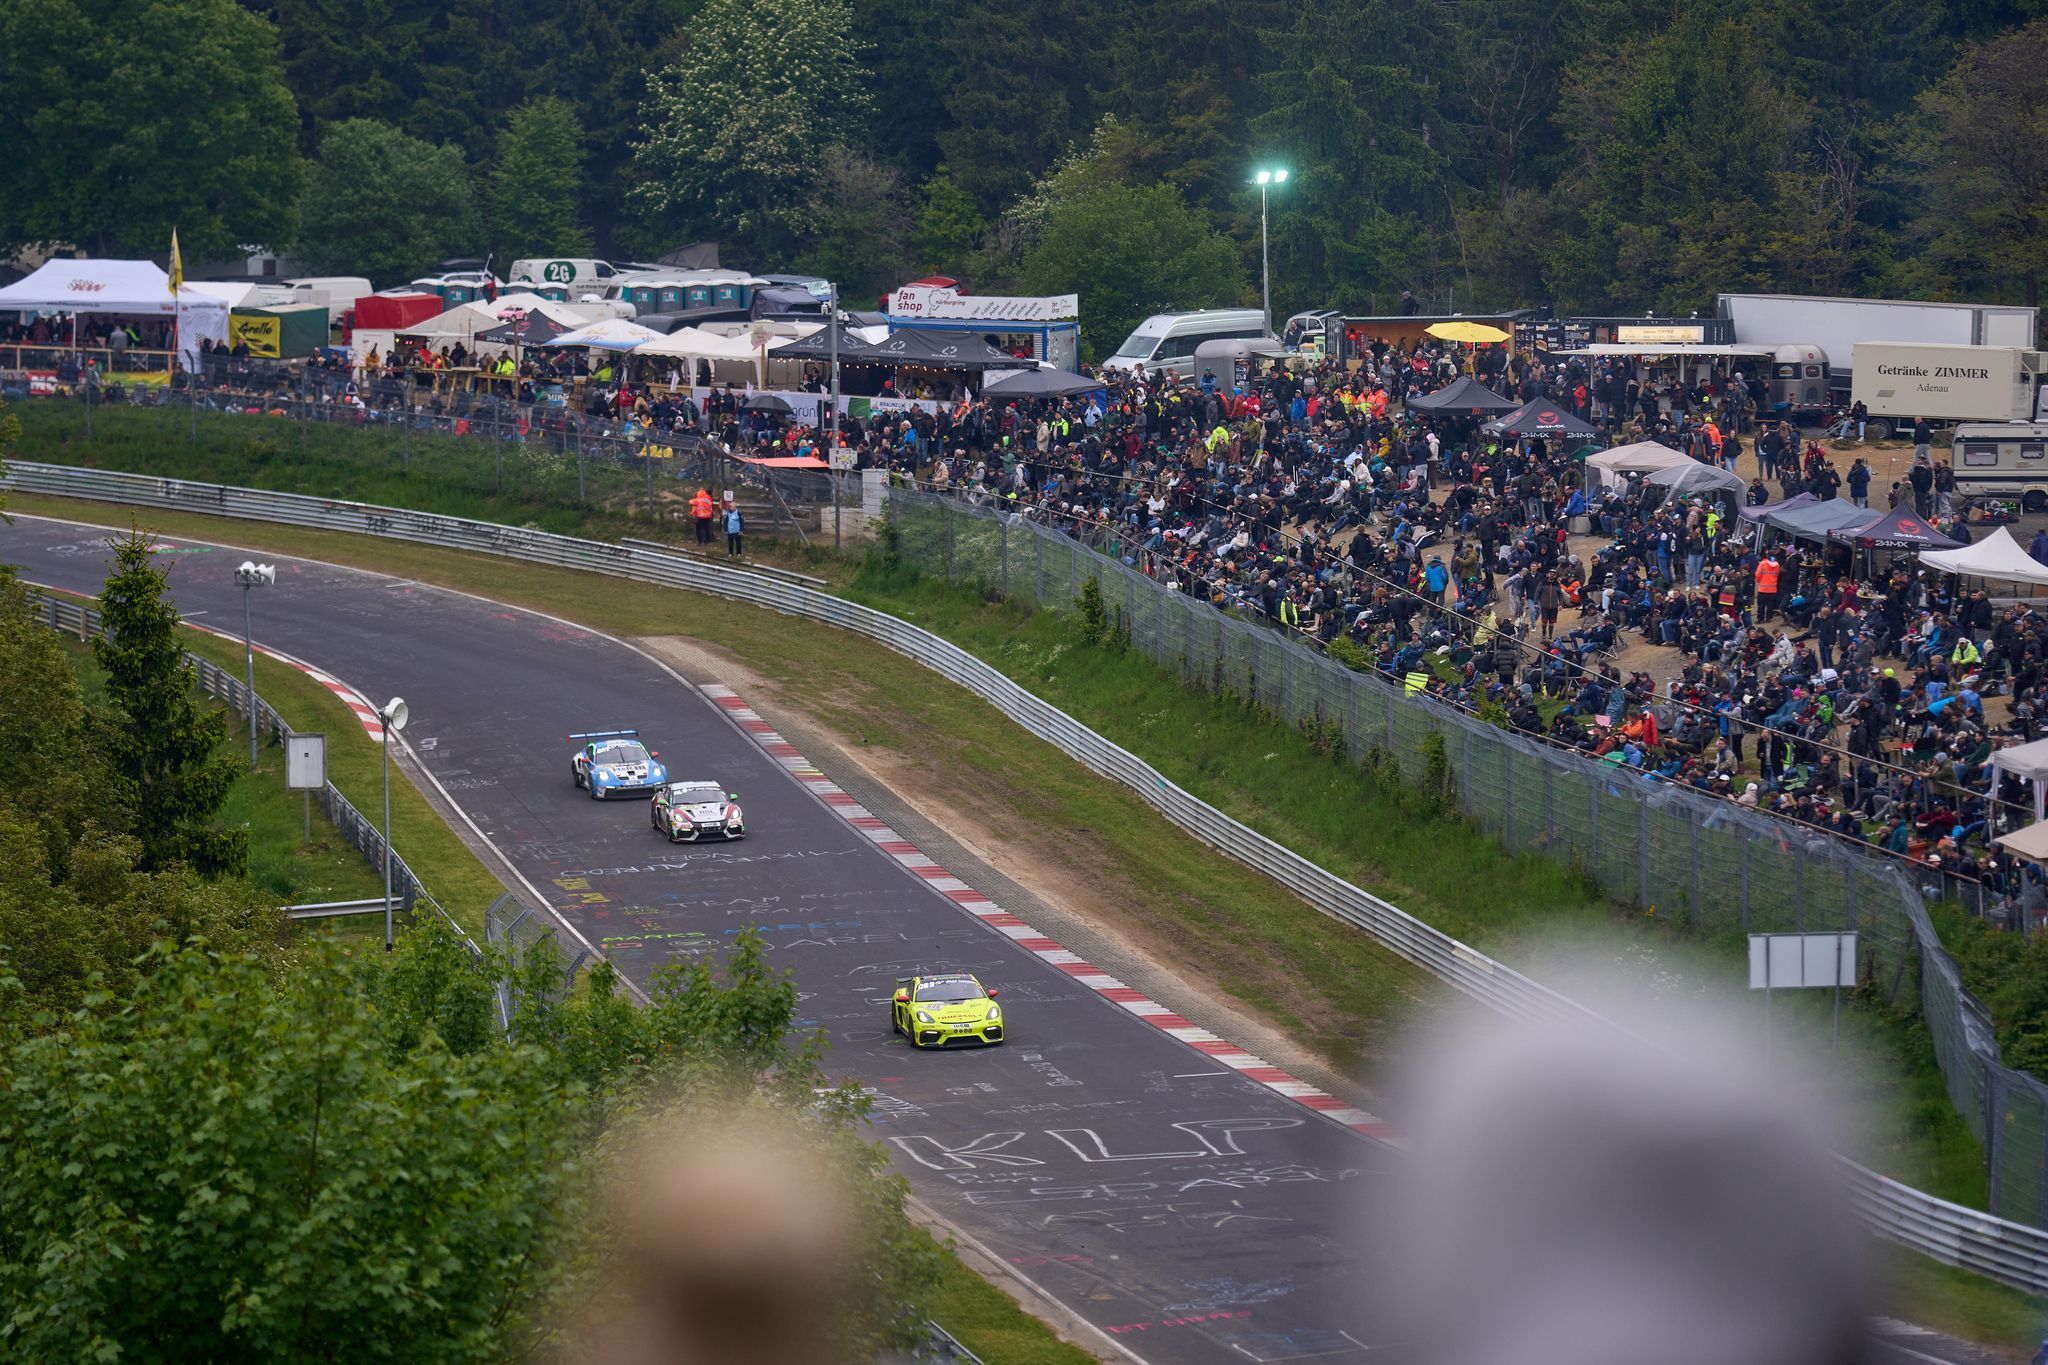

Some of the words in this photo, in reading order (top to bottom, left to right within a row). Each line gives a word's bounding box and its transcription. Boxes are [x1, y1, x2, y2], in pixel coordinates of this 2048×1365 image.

[551, 263, 570, 282] 2G
[898, 290, 915, 302] fan
[897, 301, 923, 313] shop
[238, 321, 272, 336] Grello
[1878, 364, 1929, 377] Getränke
[1934, 367, 1989, 379] ZIMMER
[1916, 383, 1949, 393] Adenau
[1875, 540, 1908, 548] 24MX
[665, 896, 781, 908] TEAM
[888, 1118, 1305, 1170] KLP
